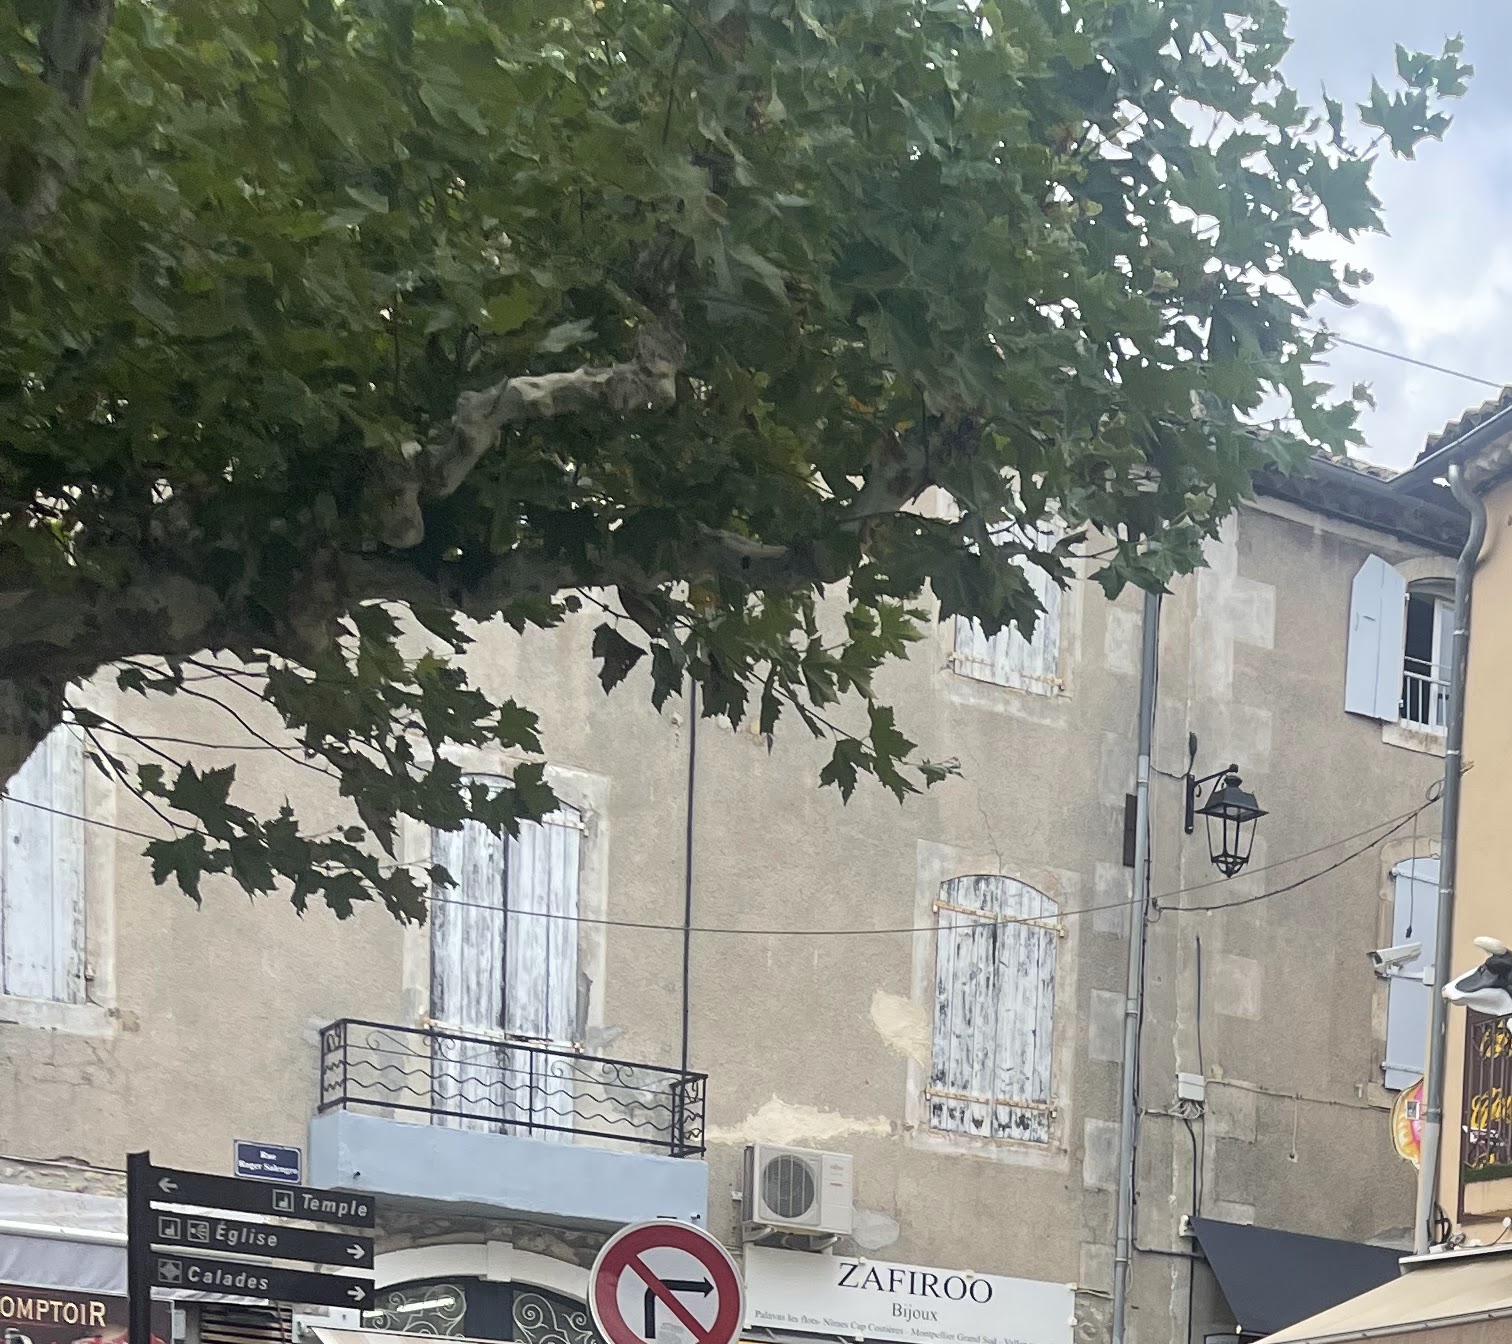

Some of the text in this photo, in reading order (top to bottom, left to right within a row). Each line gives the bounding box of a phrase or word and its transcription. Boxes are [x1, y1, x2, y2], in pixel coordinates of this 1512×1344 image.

[301, 1193, 368, 1217] Temple
[215, 1220, 278, 1246] Église
[187, 1266, 269, 1290] Calades
[837, 1262, 993, 1304] ZAFIROO
[892, 1302, 938, 1323] Bijoux
